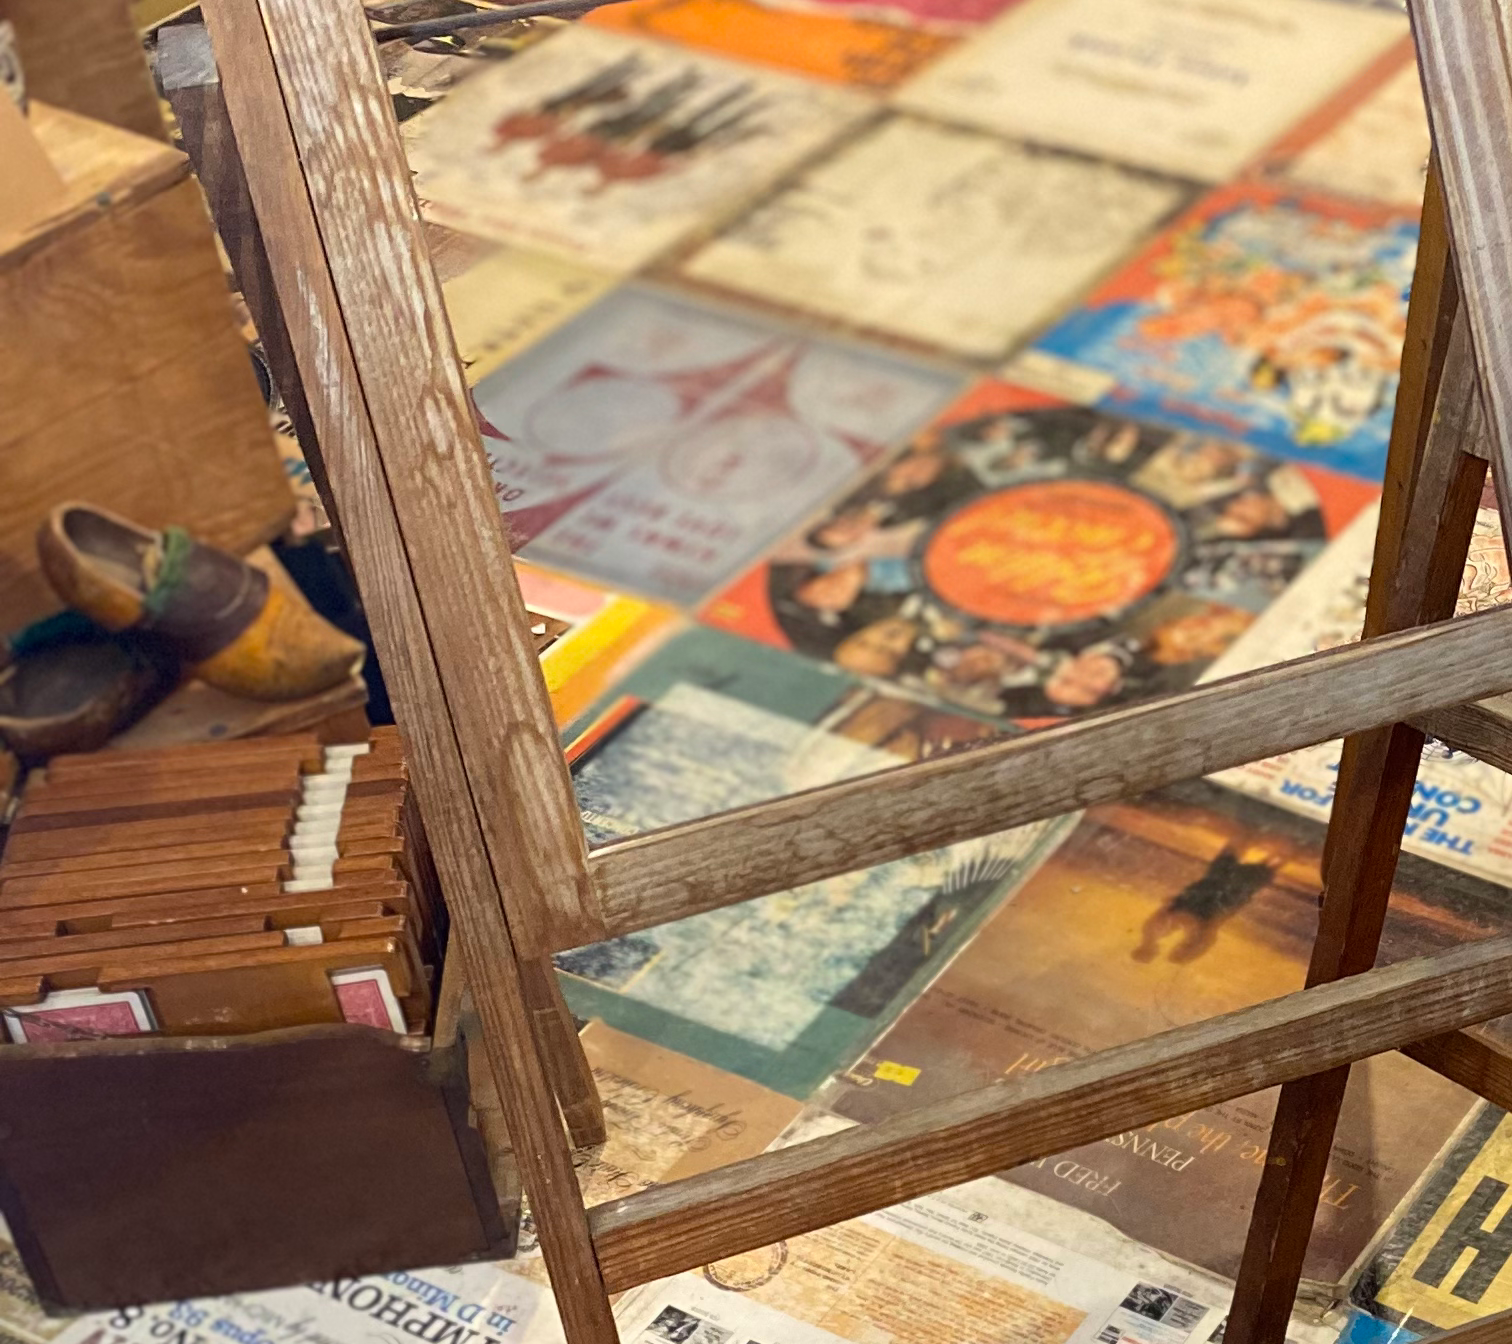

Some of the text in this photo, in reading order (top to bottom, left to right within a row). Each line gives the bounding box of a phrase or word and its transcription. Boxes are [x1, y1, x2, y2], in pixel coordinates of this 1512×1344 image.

[1281, 779, 1332, 805] FOR
[1431, 829, 1472, 854] THE
[1194, 1123, 1230, 1153] the
[1053, 1159, 1120, 1196] FRED
[382, 1260, 515, 1336] in D Mino
